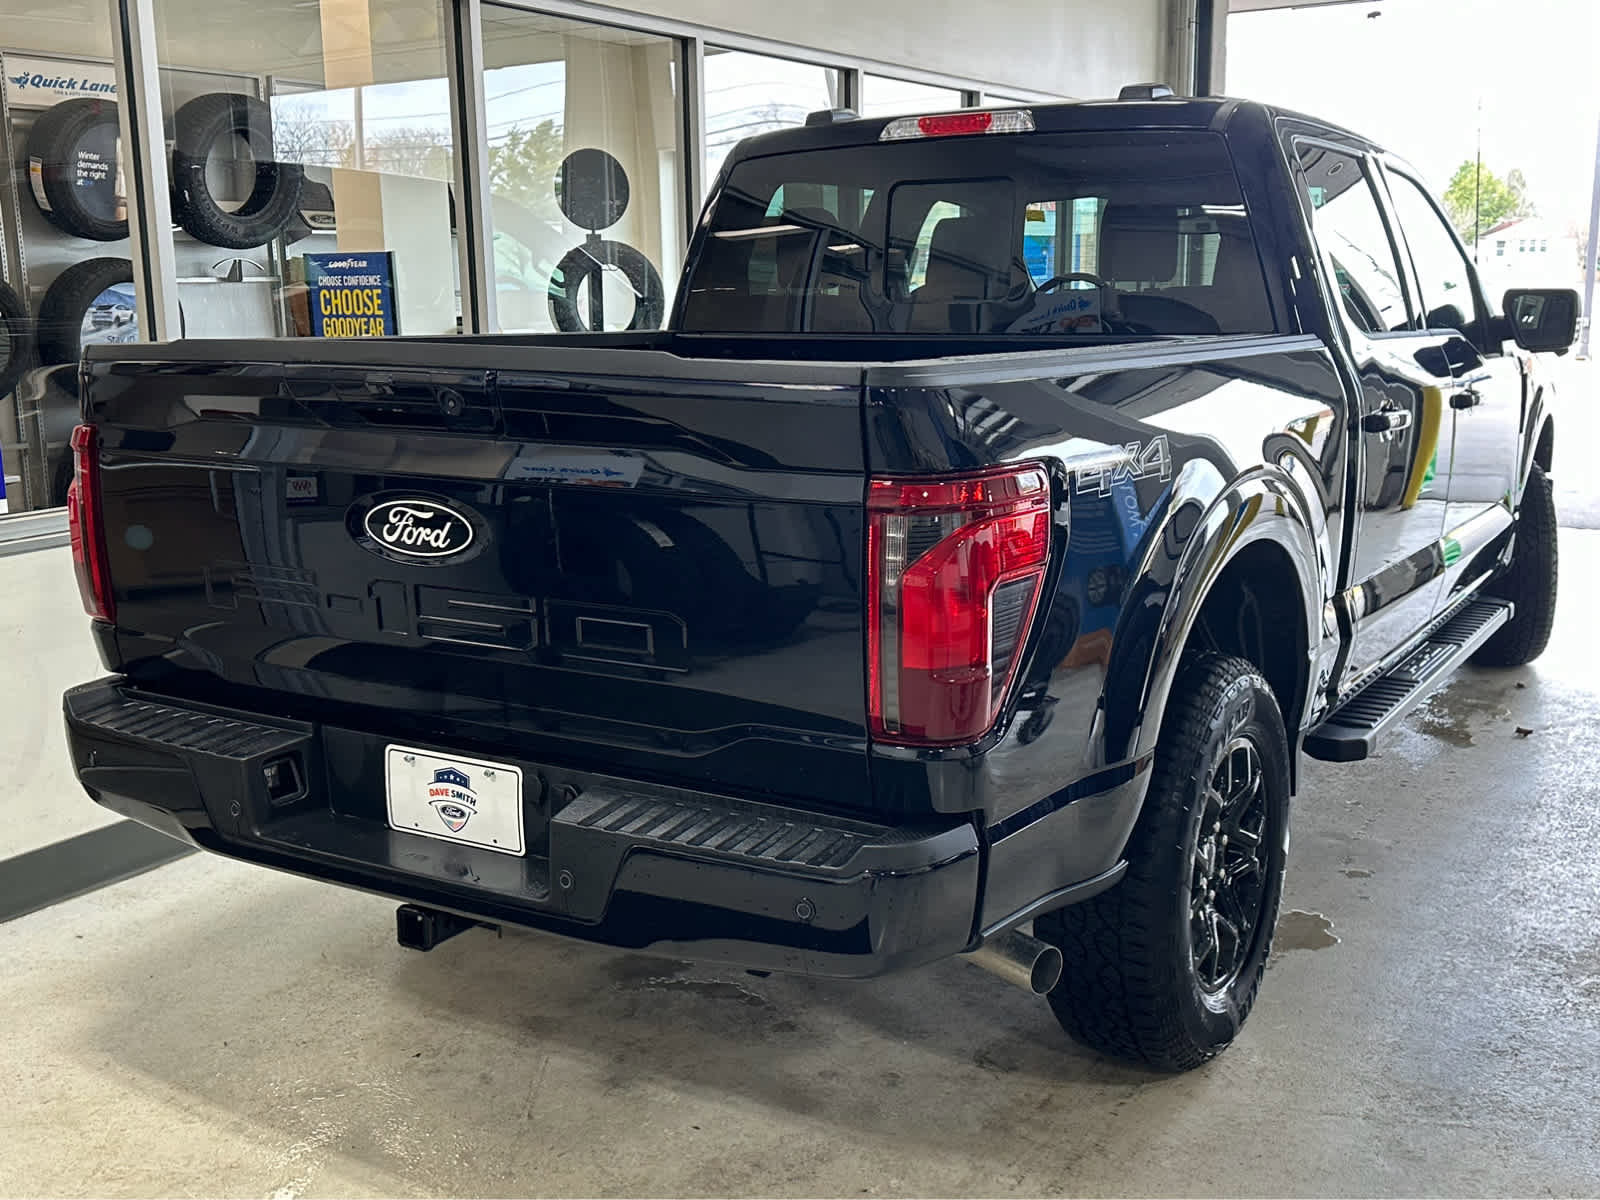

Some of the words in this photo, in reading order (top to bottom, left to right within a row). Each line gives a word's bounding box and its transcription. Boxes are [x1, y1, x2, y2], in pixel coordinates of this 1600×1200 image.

[30, 74, 77, 89] Quick
[79, 80, 117, 93] Lane
[78, 151, 100, 160] Winter
[77, 160, 109, 170] demands
[77, 169, 88, 177] the
[89, 170, 106, 180] right
[328, 258, 368, 269] GOODYEAR
[318, 275, 342, 286] CHOOSE
[343, 274, 381, 286] CONFIDENCE
[320, 289, 383, 315] CHOOSE
[323, 318, 384, 337] GOODYEAR
[382, 506, 452, 549] Ford
[428, 788, 450, 797] DAVE
[450, 789, 477, 806] SMITH
